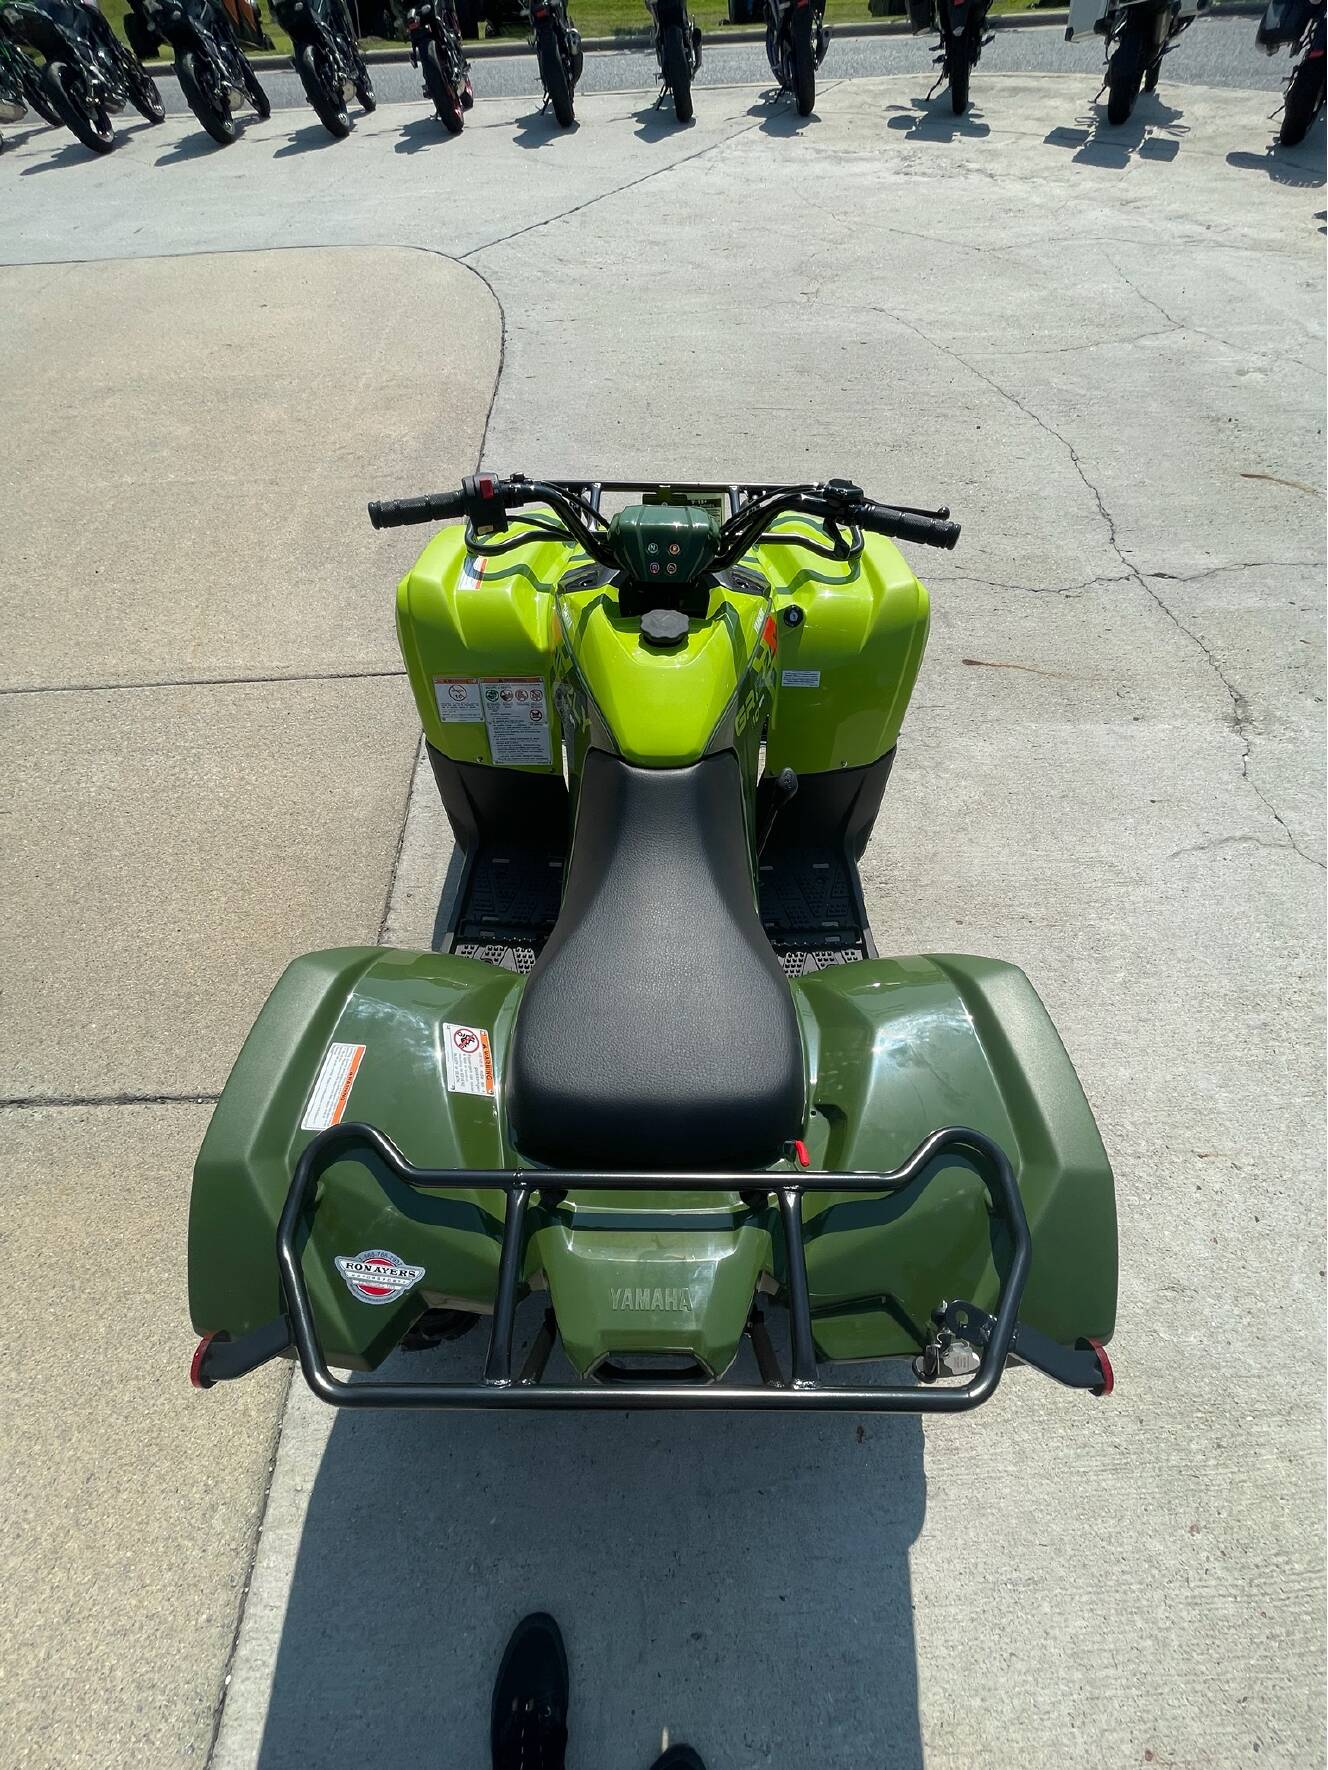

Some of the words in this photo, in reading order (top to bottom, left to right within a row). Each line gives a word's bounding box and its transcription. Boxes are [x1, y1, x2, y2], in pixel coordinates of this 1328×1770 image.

[483, 1049, 492, 1080] WARNING
[345, 1262, 372, 1272] RON
[374, 1265, 416, 1278] AYERS
[609, 1287, 693, 1311] YAMAHA
